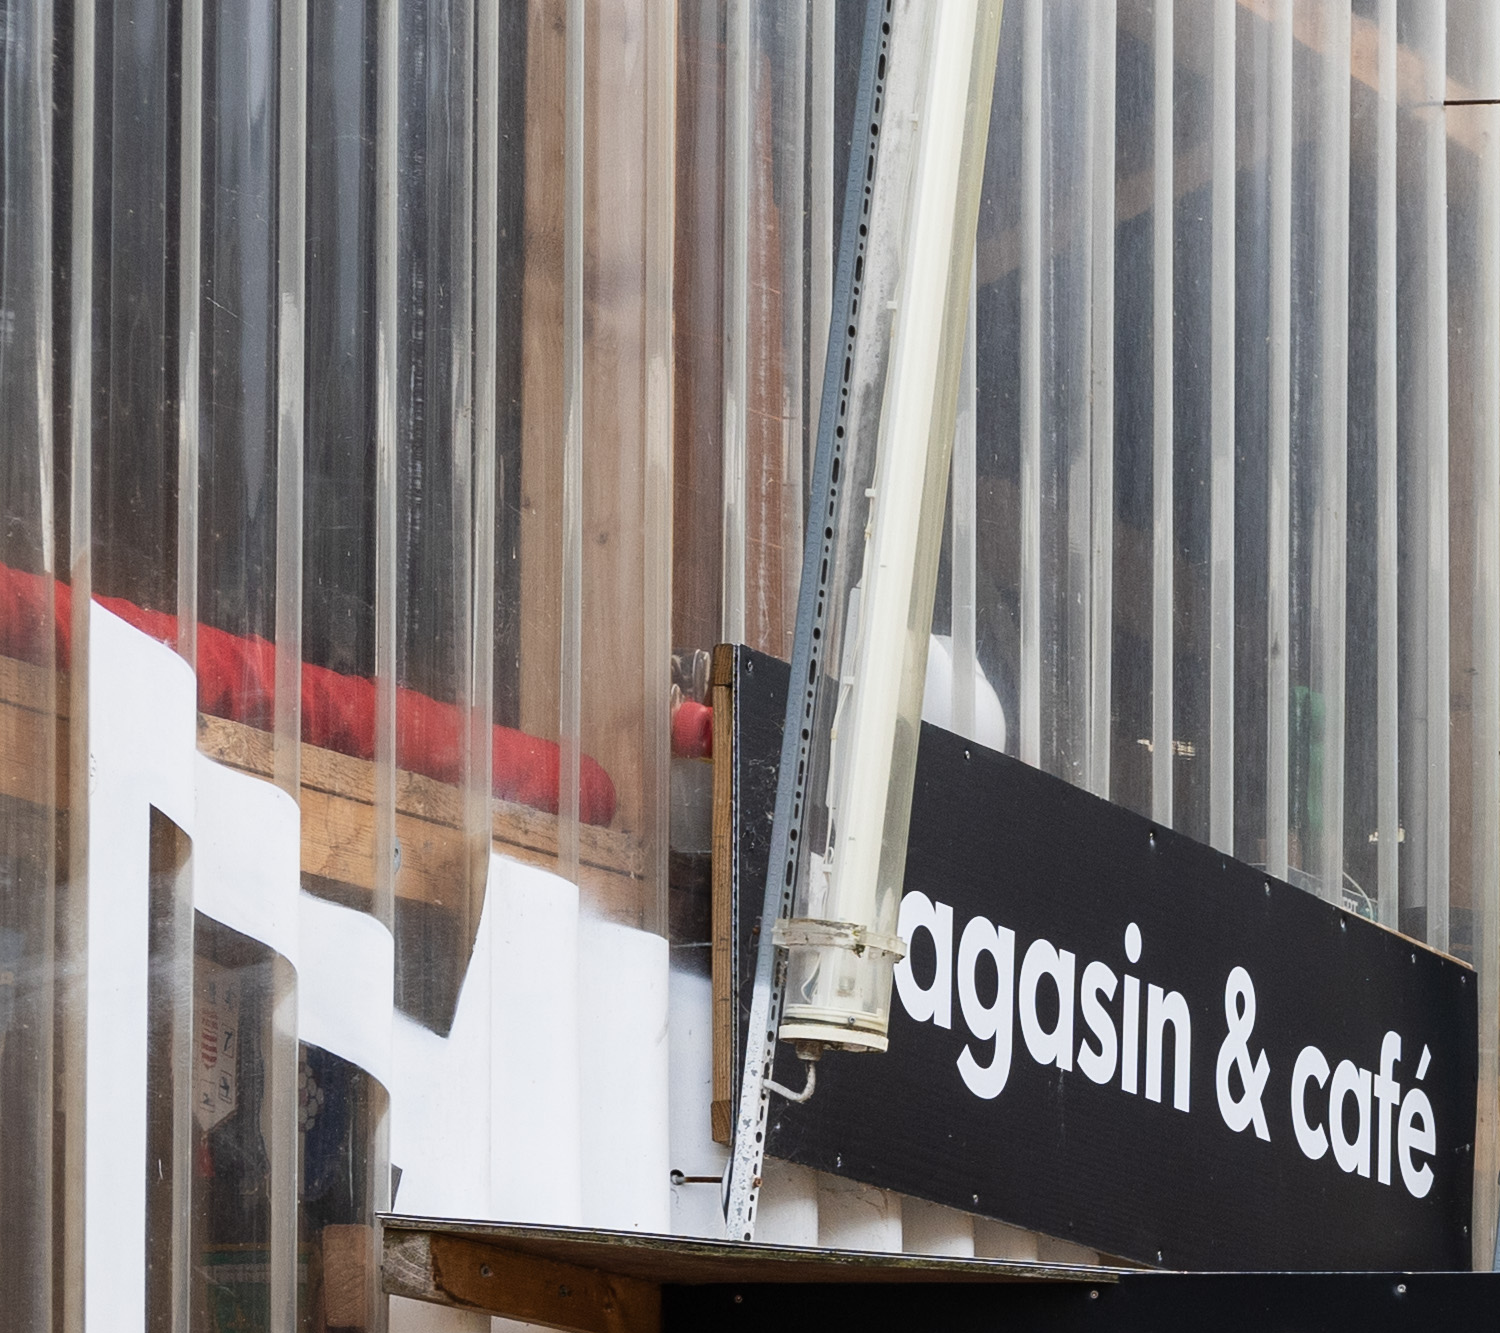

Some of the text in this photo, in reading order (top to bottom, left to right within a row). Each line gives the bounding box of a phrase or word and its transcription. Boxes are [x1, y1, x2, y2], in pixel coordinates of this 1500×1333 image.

[893, 891, 1436, 1198] agasin & café
